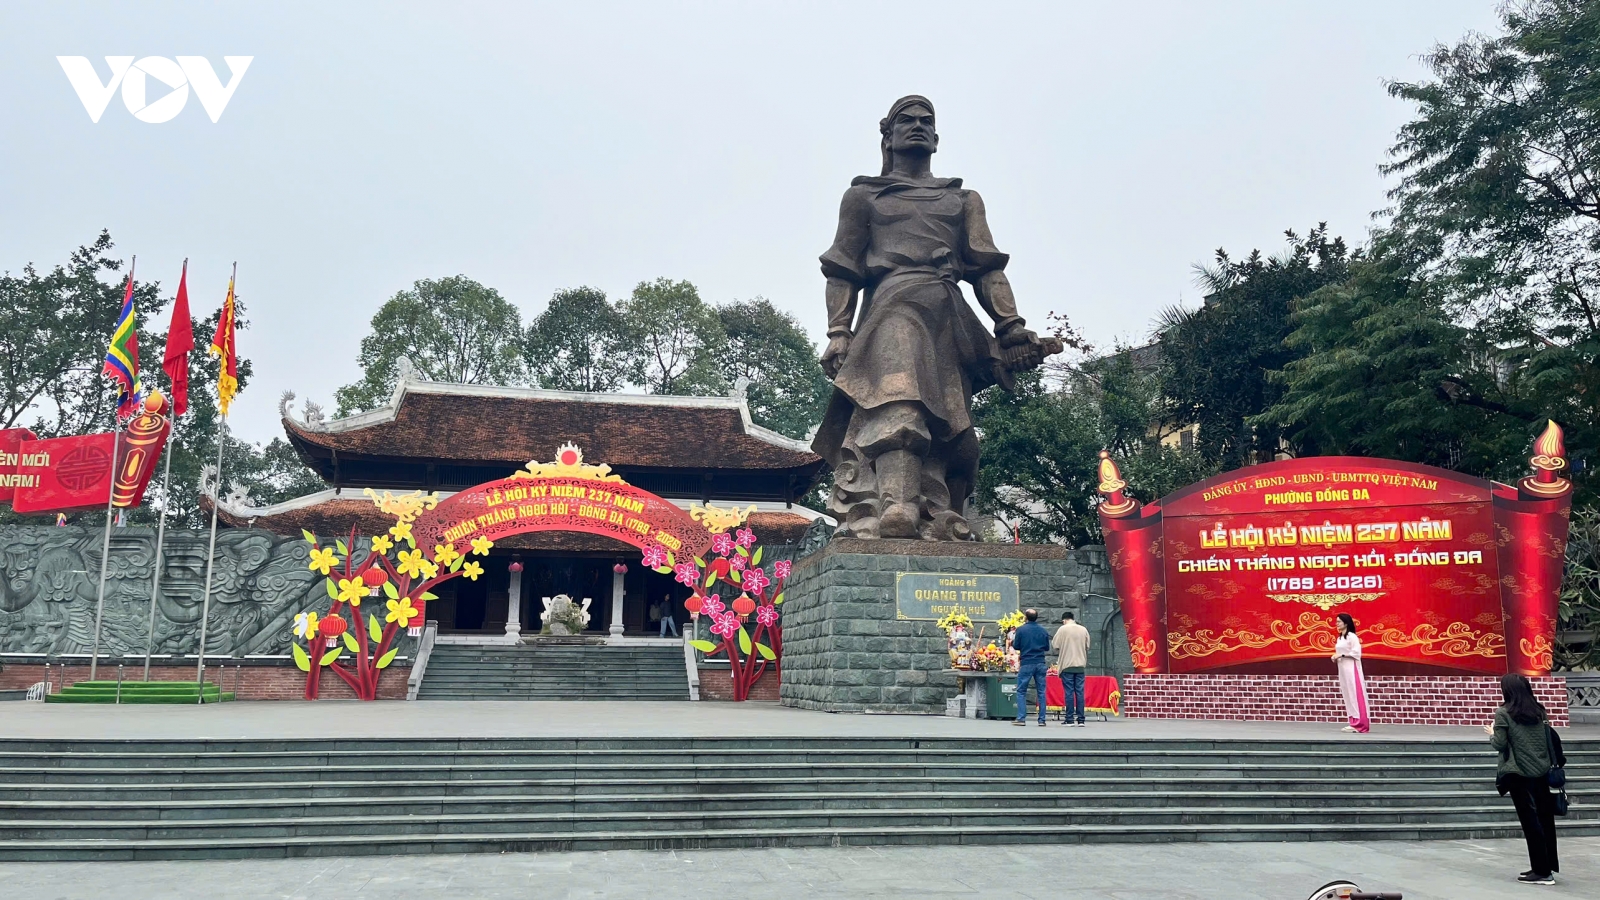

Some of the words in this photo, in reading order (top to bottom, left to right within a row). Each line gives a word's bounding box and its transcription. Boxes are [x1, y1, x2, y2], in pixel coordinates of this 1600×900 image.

[22, 450, 50, 466] MỚI
[1203, 487, 1232, 501] ĐẢNG
[1233, 480, 1247, 493] ỦY
[1255, 476, 1286, 489] HĐND
[1293, 473, 1324, 483] UBND
[1332, 473, 1379, 485] UBMTTQ
[1382, 474, 1409, 487] VIỆT
[1410, 478, 1438, 490] NAM
[1264, 490, 1312, 504] PHƯỜNG
[1315, 487, 1349, 502] ĐỐNG
[1352, 488, 1370, 500] ĐA
[485, 489, 502, 507] LỄ
[505, 486, 527, 502] HỘI
[530, 483, 548, 498] KỶ
[551, 484, 585, 499] NIỆM
[588, 490, 611, 503] 237
[613, 495, 644, 514] NĂM
[444, 518, 478, 542] CHIẾN
[579, 504, 606, 520] ĐỐNG
[609, 511, 624, 525] ĐA
[626, 517, 650, 534] (1789
[655, 531, 681, 550] 2026)
[1200, 522, 1228, 548] LỄ
[1230, 524, 1265, 551] HỘI
[1266, 521, 1297, 546] KỶ
[1299, 520, 1353, 549] NIỆM
[1355, 522, 1399, 543] 237
[1401, 517, 1452, 542] NĂM
[1178, 554, 1231, 572] CHIẾN
[1234, 553, 1295, 570] THẮNG
[1299, 555, 1350, 571] NGỌC
[1354, 548, 1386, 567] HỒI
[1394, 547, 1450, 566] ĐỐNG
[1453, 551, 1482, 565] ĐA
[939, 577, 965, 586] HOÀNG
[1267, 577, 1314, 590] (1789
[1324, 575, 1382, 589] 2026)
[915, 590, 957, 602] QUANG
[960, 591, 1001, 602] TRUNG
[968, 604, 985, 616] HUỆ
